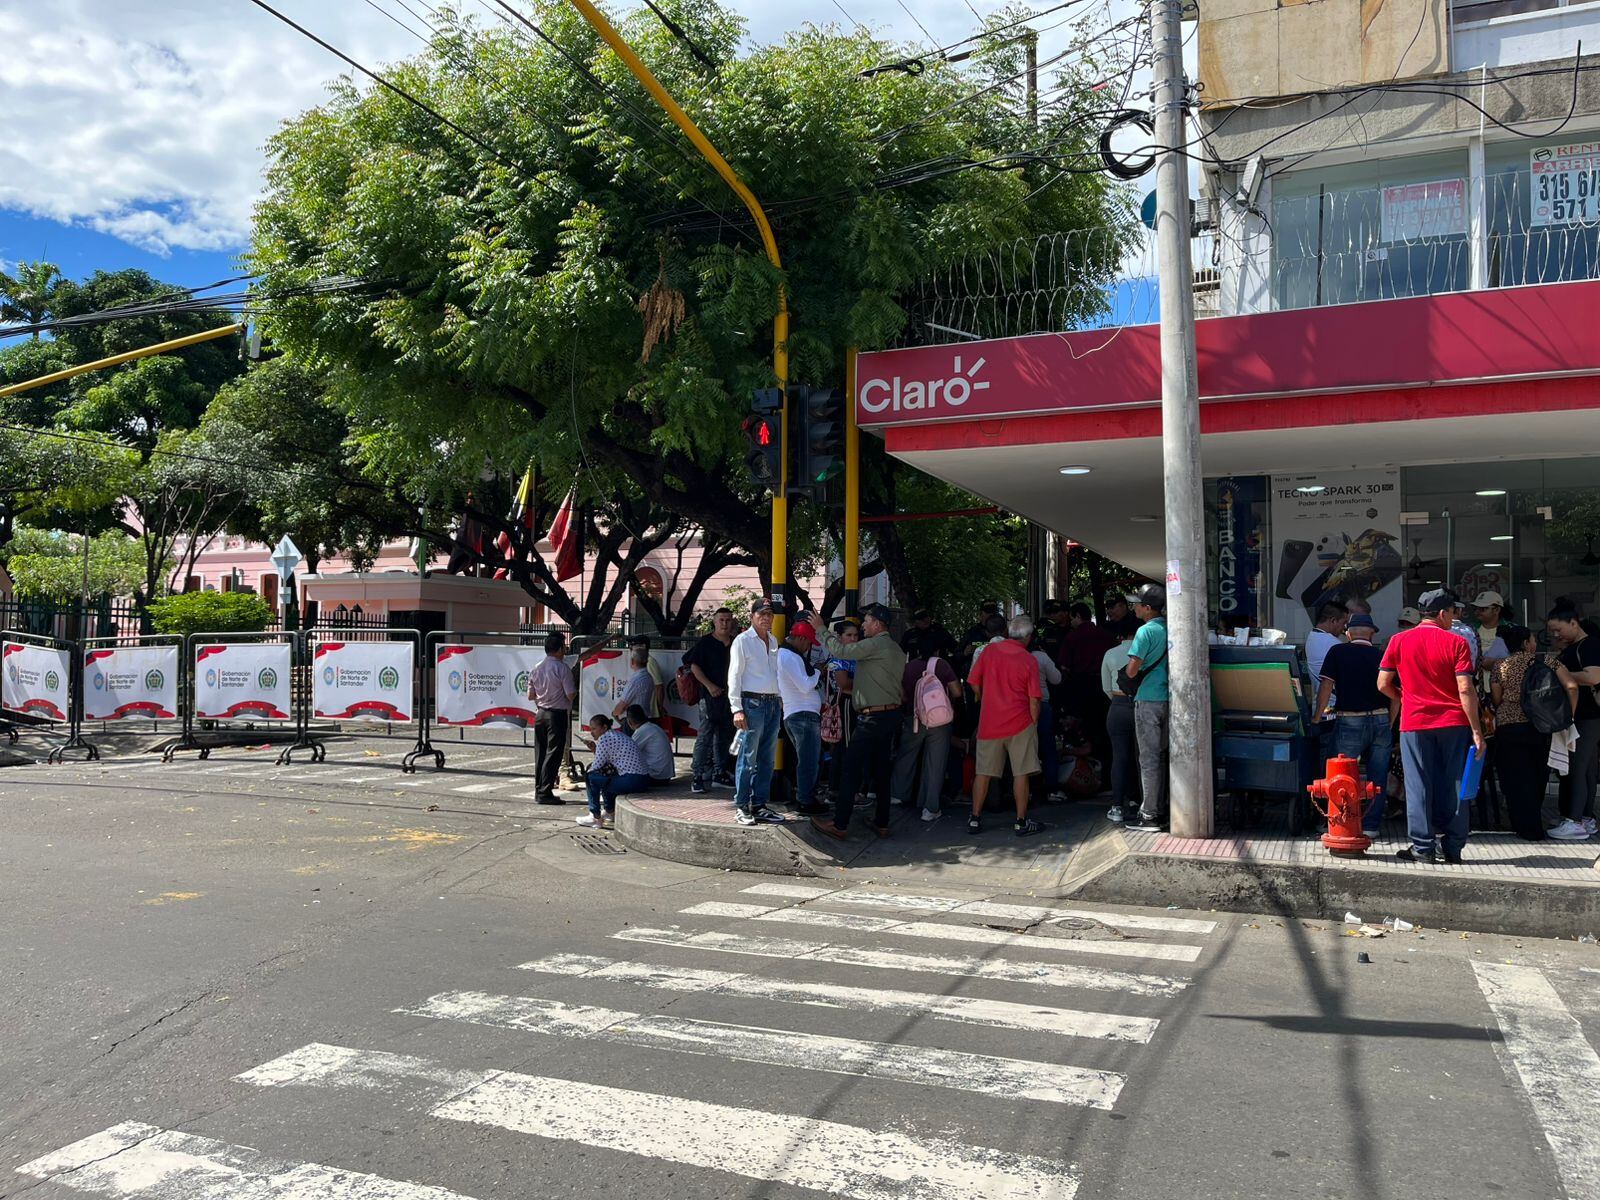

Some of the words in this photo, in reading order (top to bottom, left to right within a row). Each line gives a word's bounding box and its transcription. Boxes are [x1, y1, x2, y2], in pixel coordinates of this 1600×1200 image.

[1539, 172, 1570, 201] 315
[1578, 170, 1600, 197] 67
[1553, 198, 1587, 220] 571
[860, 376, 971, 413] Claro
[1324, 485, 1362, 496] SPARK
[1366, 484, 1380, 494] 30
[1220, 530, 1238, 611] BANCO
